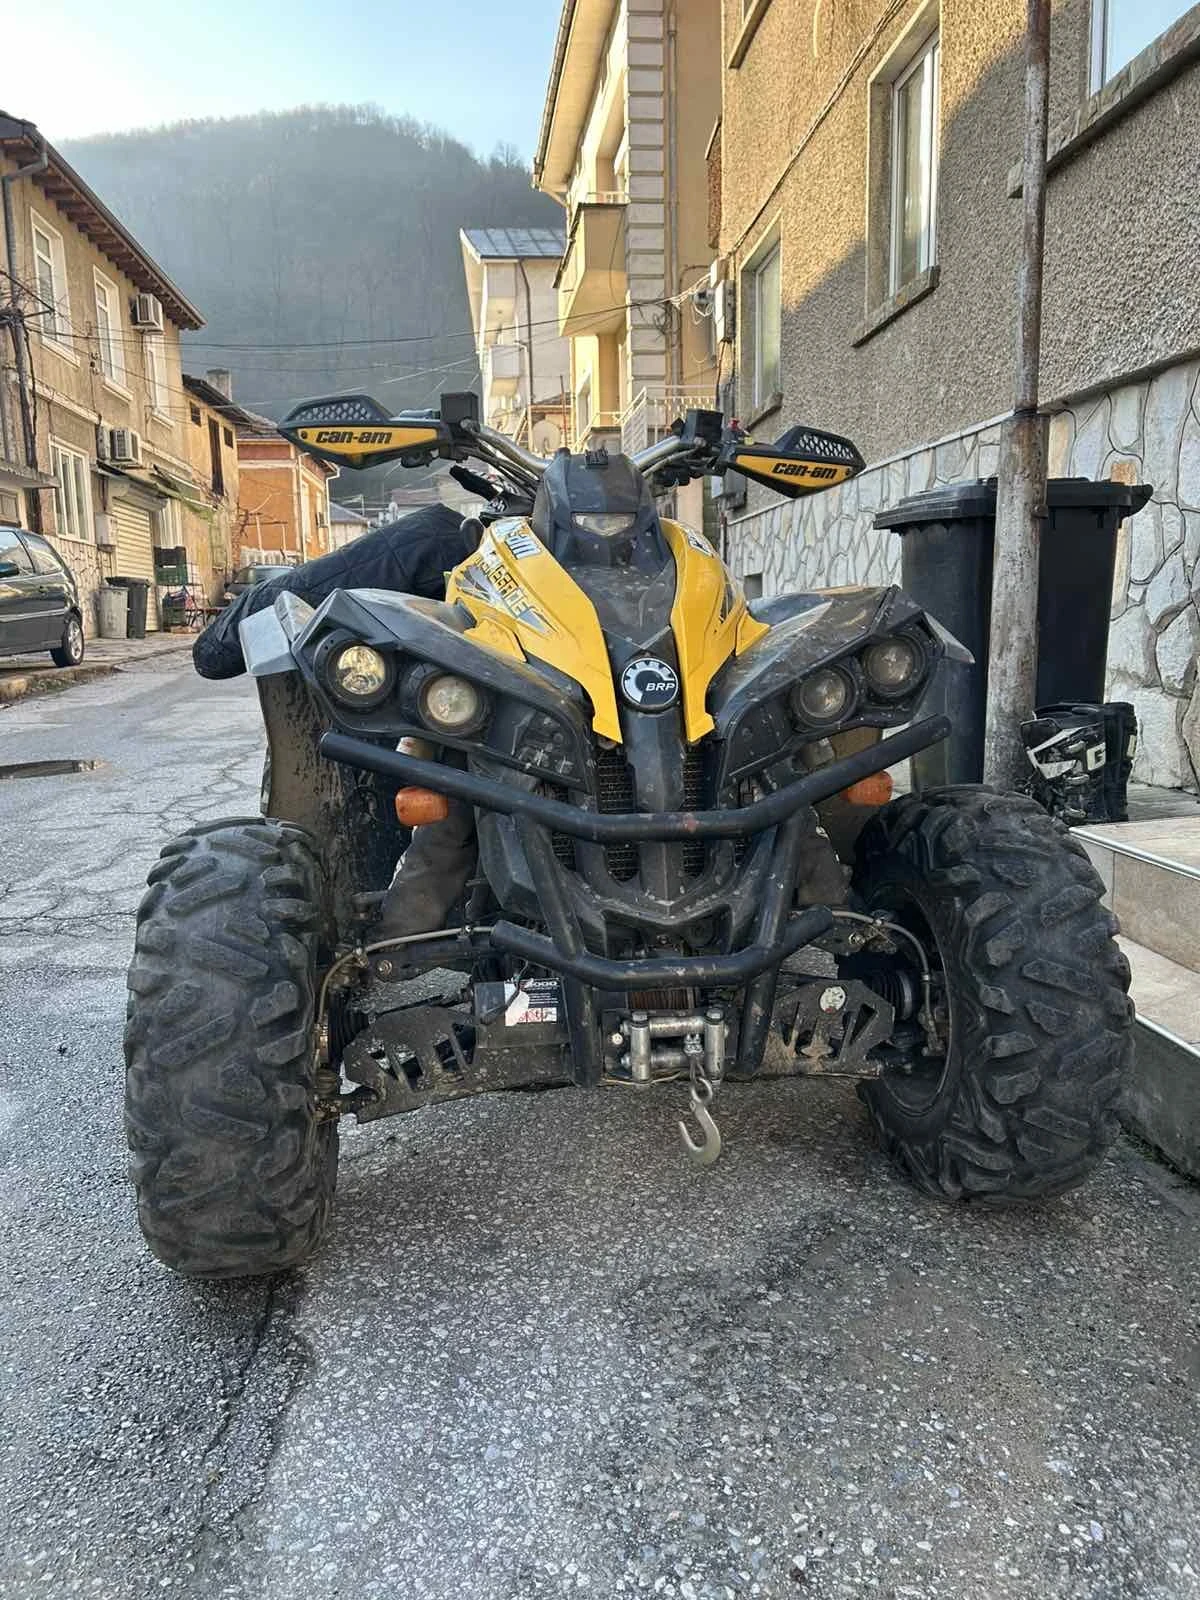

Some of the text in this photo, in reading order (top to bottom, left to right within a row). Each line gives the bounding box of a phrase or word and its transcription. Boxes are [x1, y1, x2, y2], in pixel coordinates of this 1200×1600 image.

[316, 431, 393, 444] can-am
[772, 462, 838, 479] can-am
[645, 682, 676, 692] BRP
